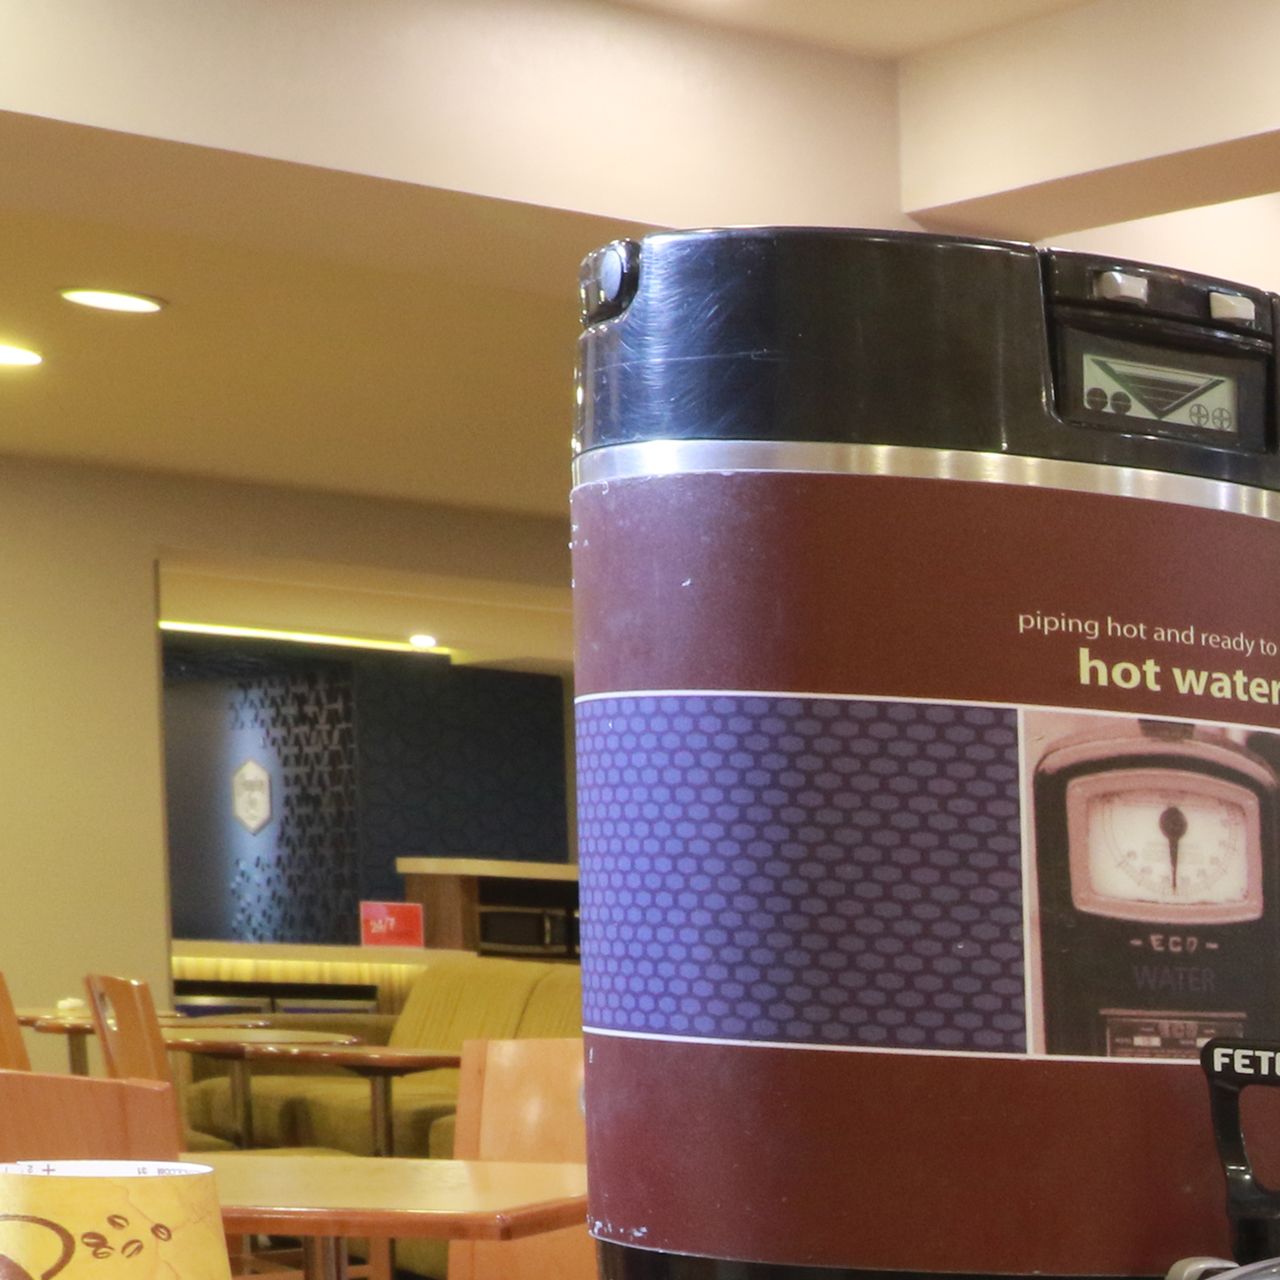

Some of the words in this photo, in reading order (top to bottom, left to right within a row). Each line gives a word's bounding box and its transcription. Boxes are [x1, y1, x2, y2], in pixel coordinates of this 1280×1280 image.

[1018, 610, 1099, 640] piping
[1107, 616, 1147, 640] hot
[1153, 625, 1194, 646] and
[1201, 632, 1255, 657] ready
[1260, 638, 1277, 656] to
[1079, 647, 1161, 692] hot
